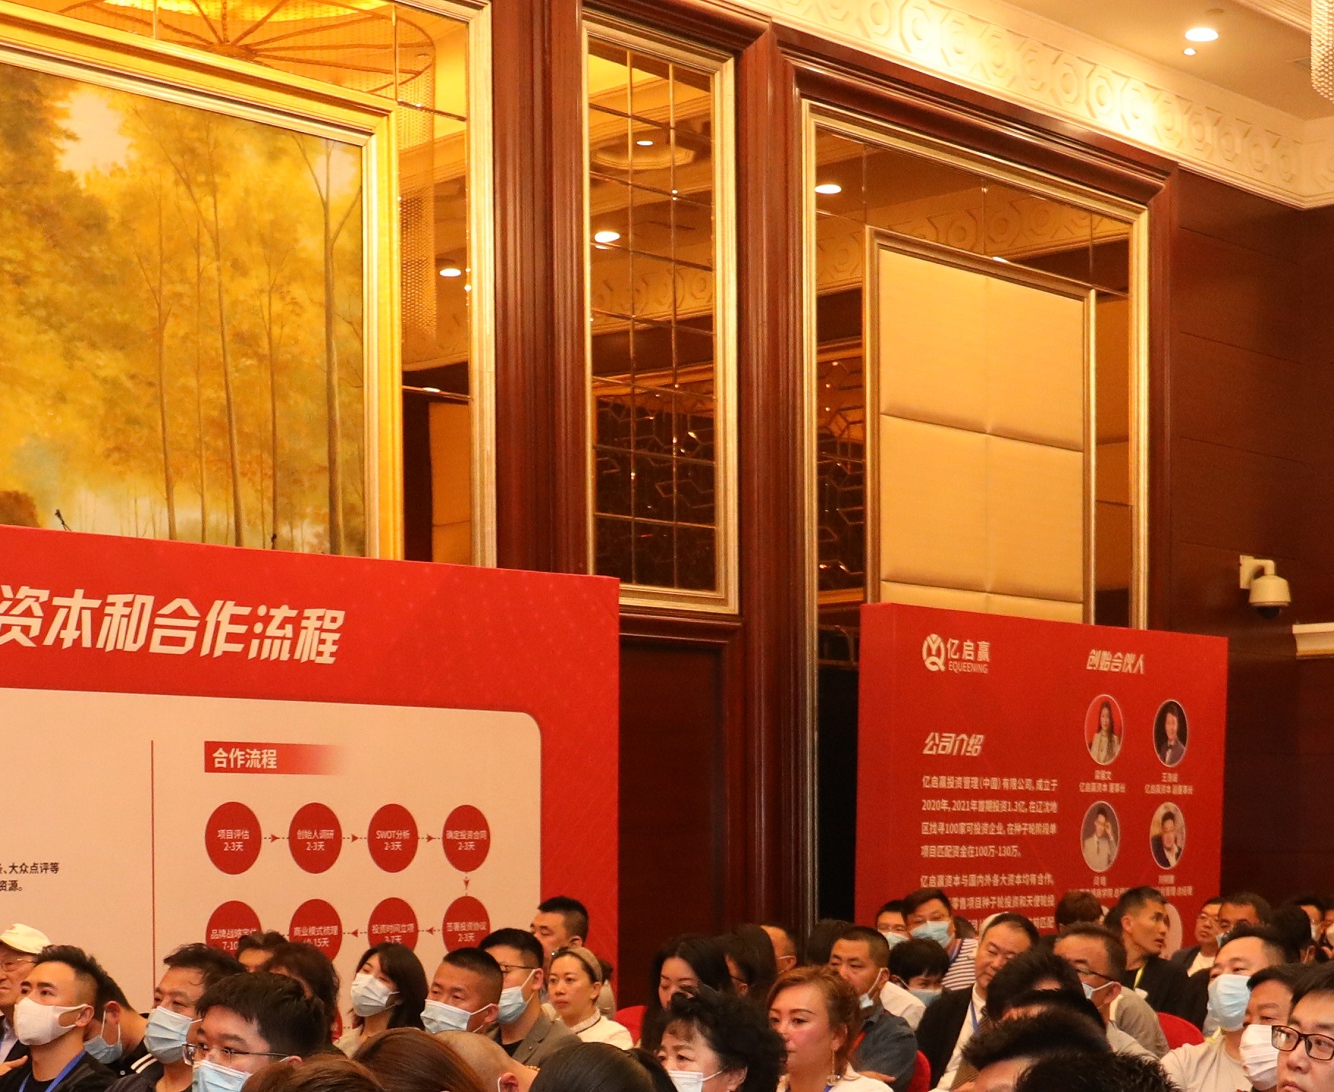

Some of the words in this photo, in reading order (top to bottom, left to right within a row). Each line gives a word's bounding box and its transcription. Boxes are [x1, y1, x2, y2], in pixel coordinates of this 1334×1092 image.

[946, 637, 991, 662] 亿启赢
[1086, 649, 1145, 674] 创始合伙人
[922, 732, 986, 756] 公司介绍
[212, 747, 278, 769] 合作流程
[217, 829, 250, 840] 项目评估
[296, 829, 335, 840] 创始人调研
[376, 830, 411, 840] SWOT分析
[223, 842, 244, 851] 2-3天
[306, 842, 325, 851] 2-3天
[384, 842, 402, 851] 2-3天
